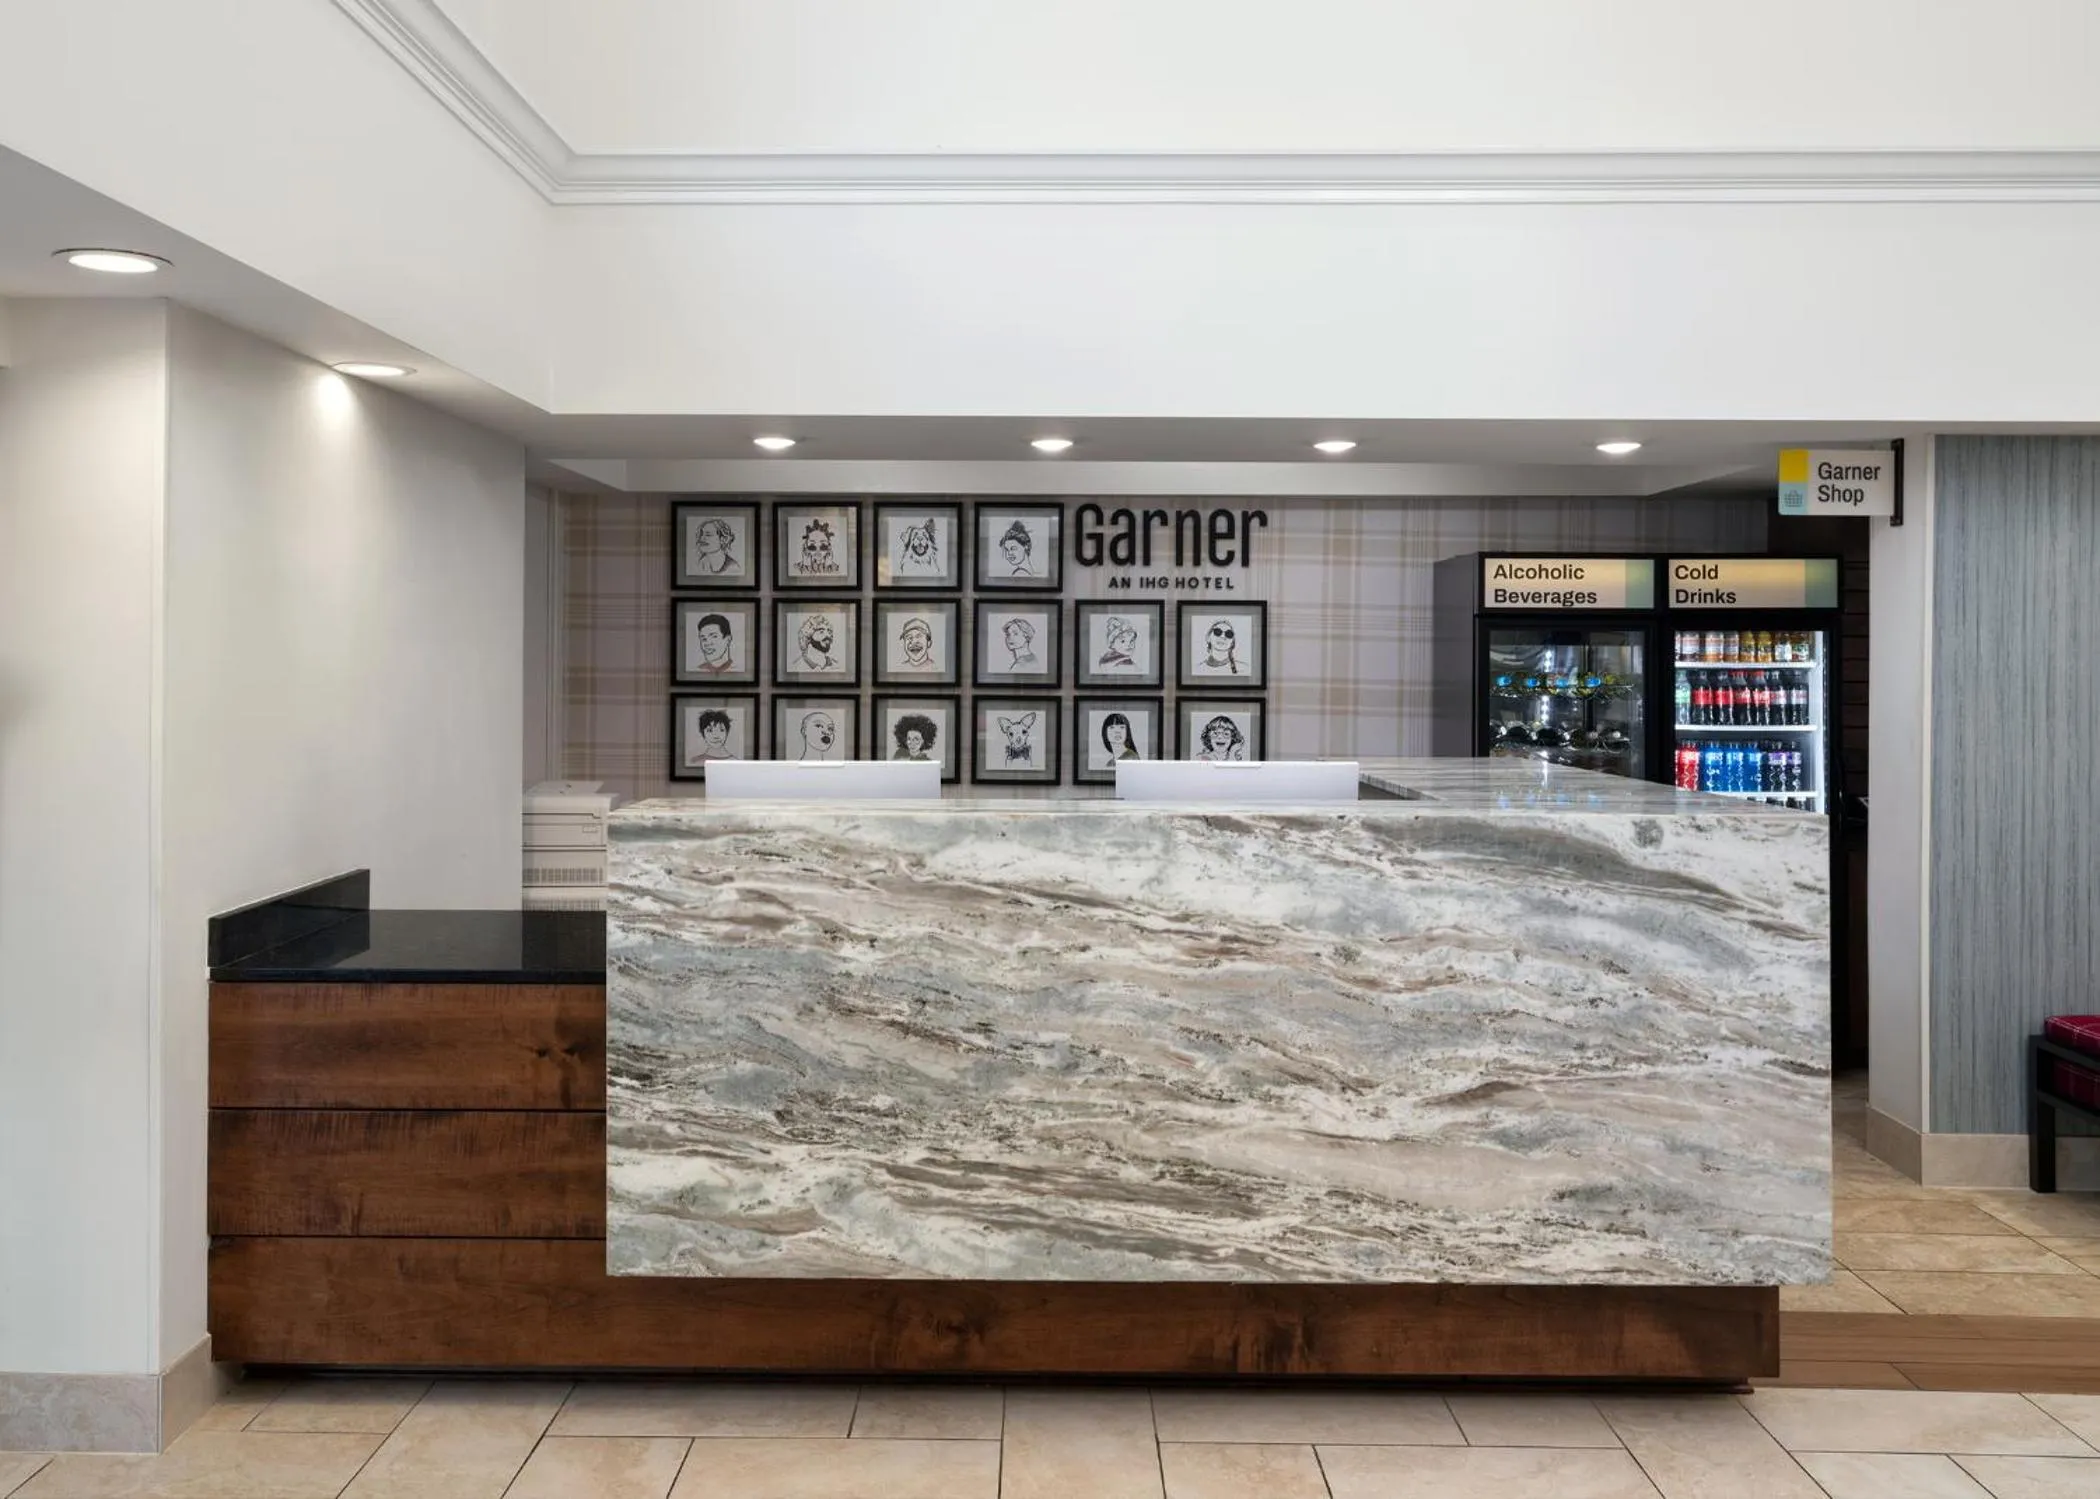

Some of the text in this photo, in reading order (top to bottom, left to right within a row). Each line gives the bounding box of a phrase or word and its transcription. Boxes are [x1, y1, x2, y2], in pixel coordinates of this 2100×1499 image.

[1817, 461, 1882, 481] Garner
[1817, 484, 1865, 507] Shop
[1074, 503, 1268, 568] Garner
[1493, 563, 1585, 580] Alcoholic
[1674, 564, 1719, 580] Cold
[1108, 576, 1235, 590] AN IHG HOTEL
[1494, 588, 1598, 608] Beverages
[1674, 588, 1737, 604] Drinks
